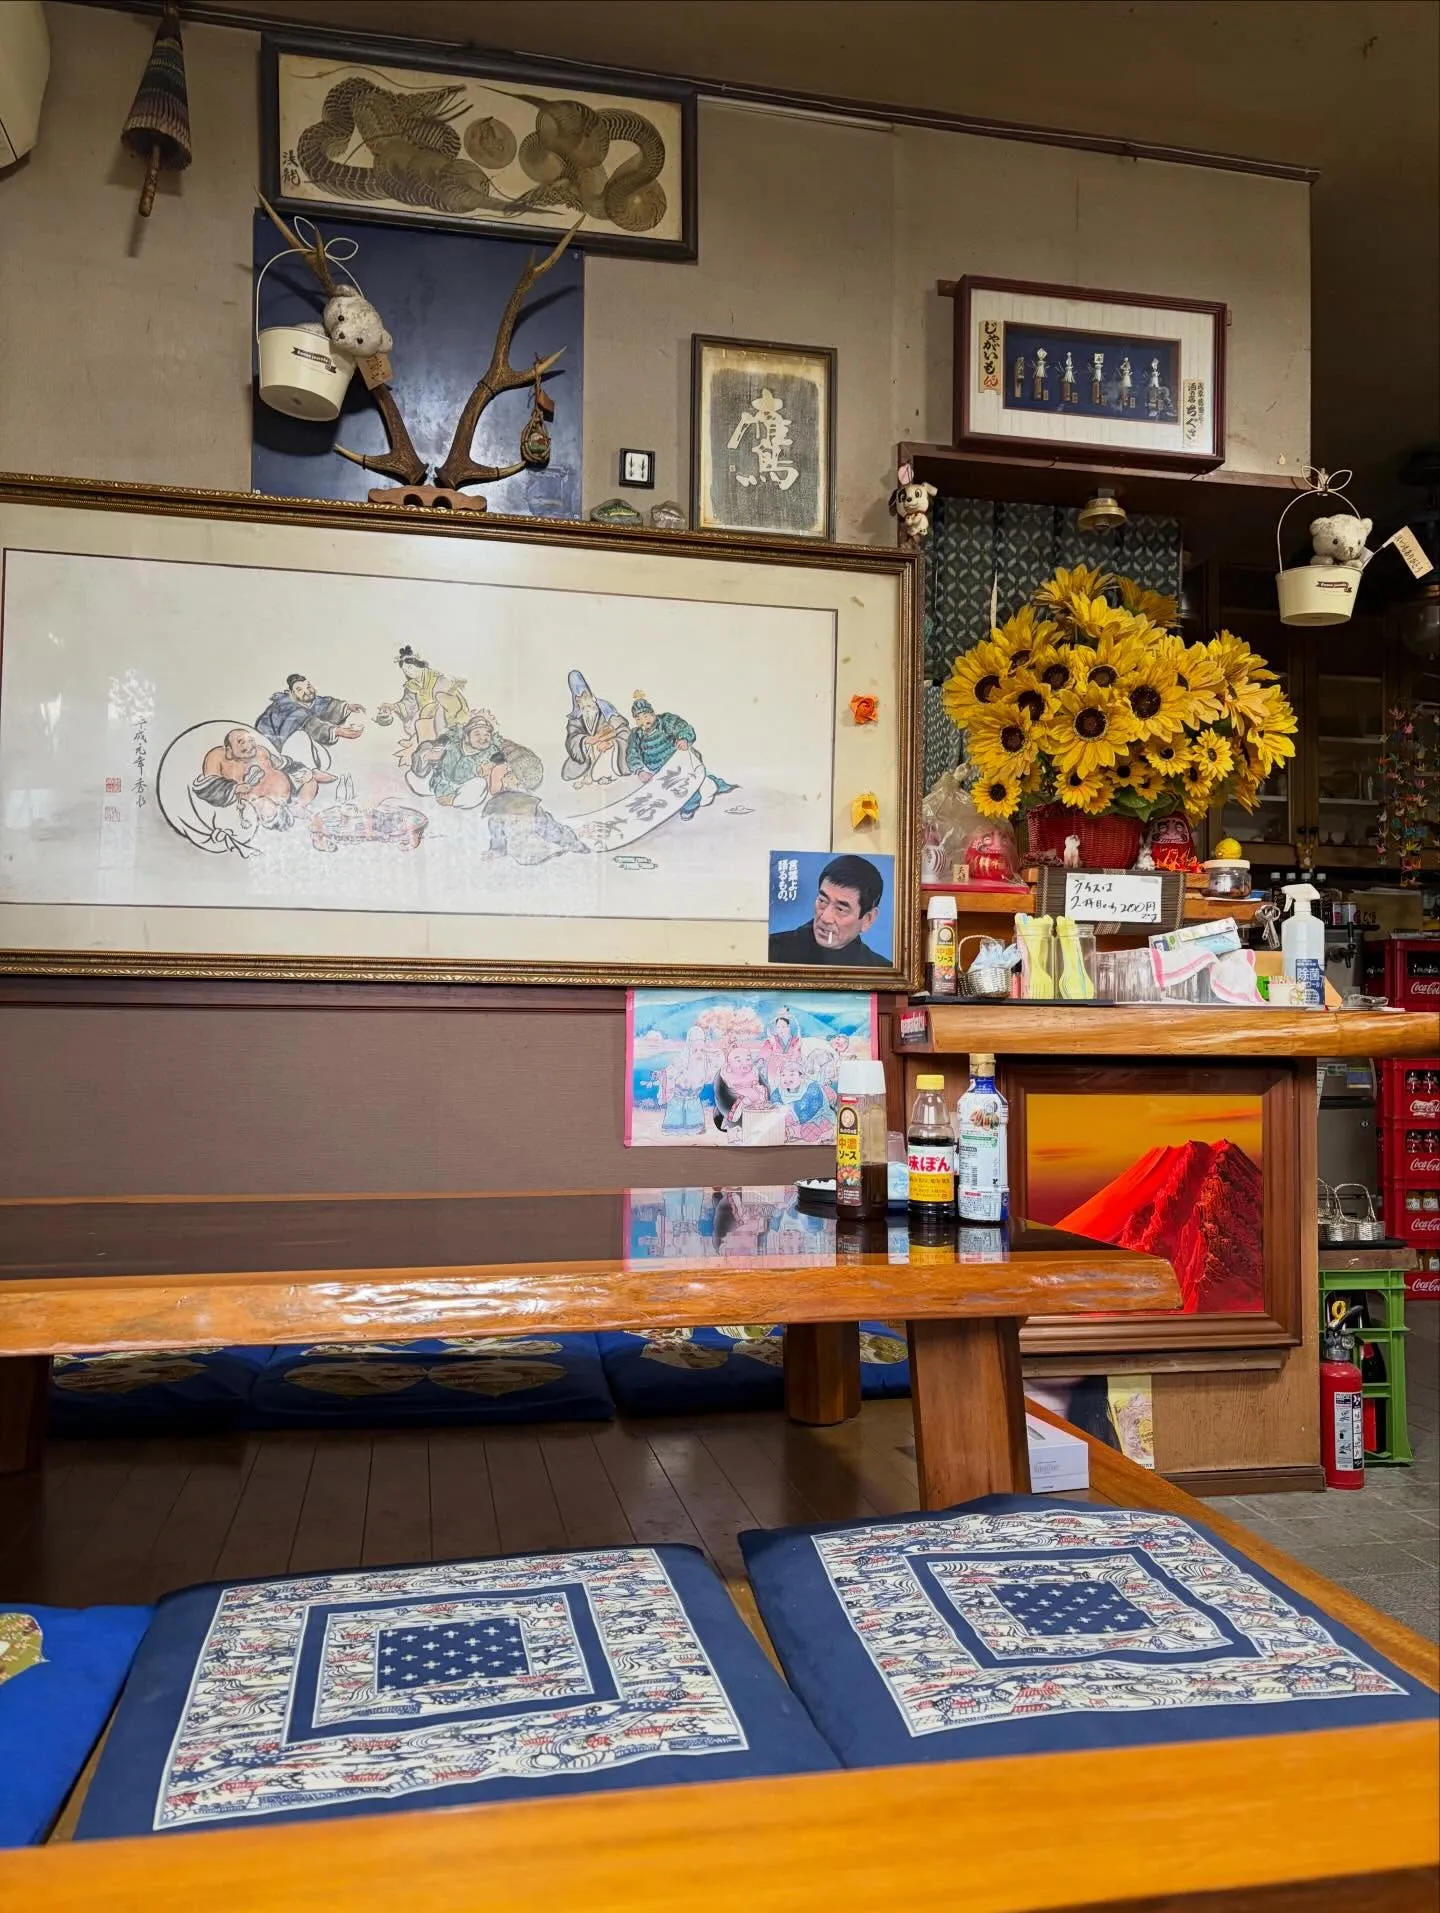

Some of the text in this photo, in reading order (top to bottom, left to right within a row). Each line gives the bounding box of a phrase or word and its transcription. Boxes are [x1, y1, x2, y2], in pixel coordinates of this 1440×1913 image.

[1297, 968, 1320, 981] 除菌
[839, 1150, 857, 1160] ソース
[908, 1155, 950, 1172] 味ぽん
